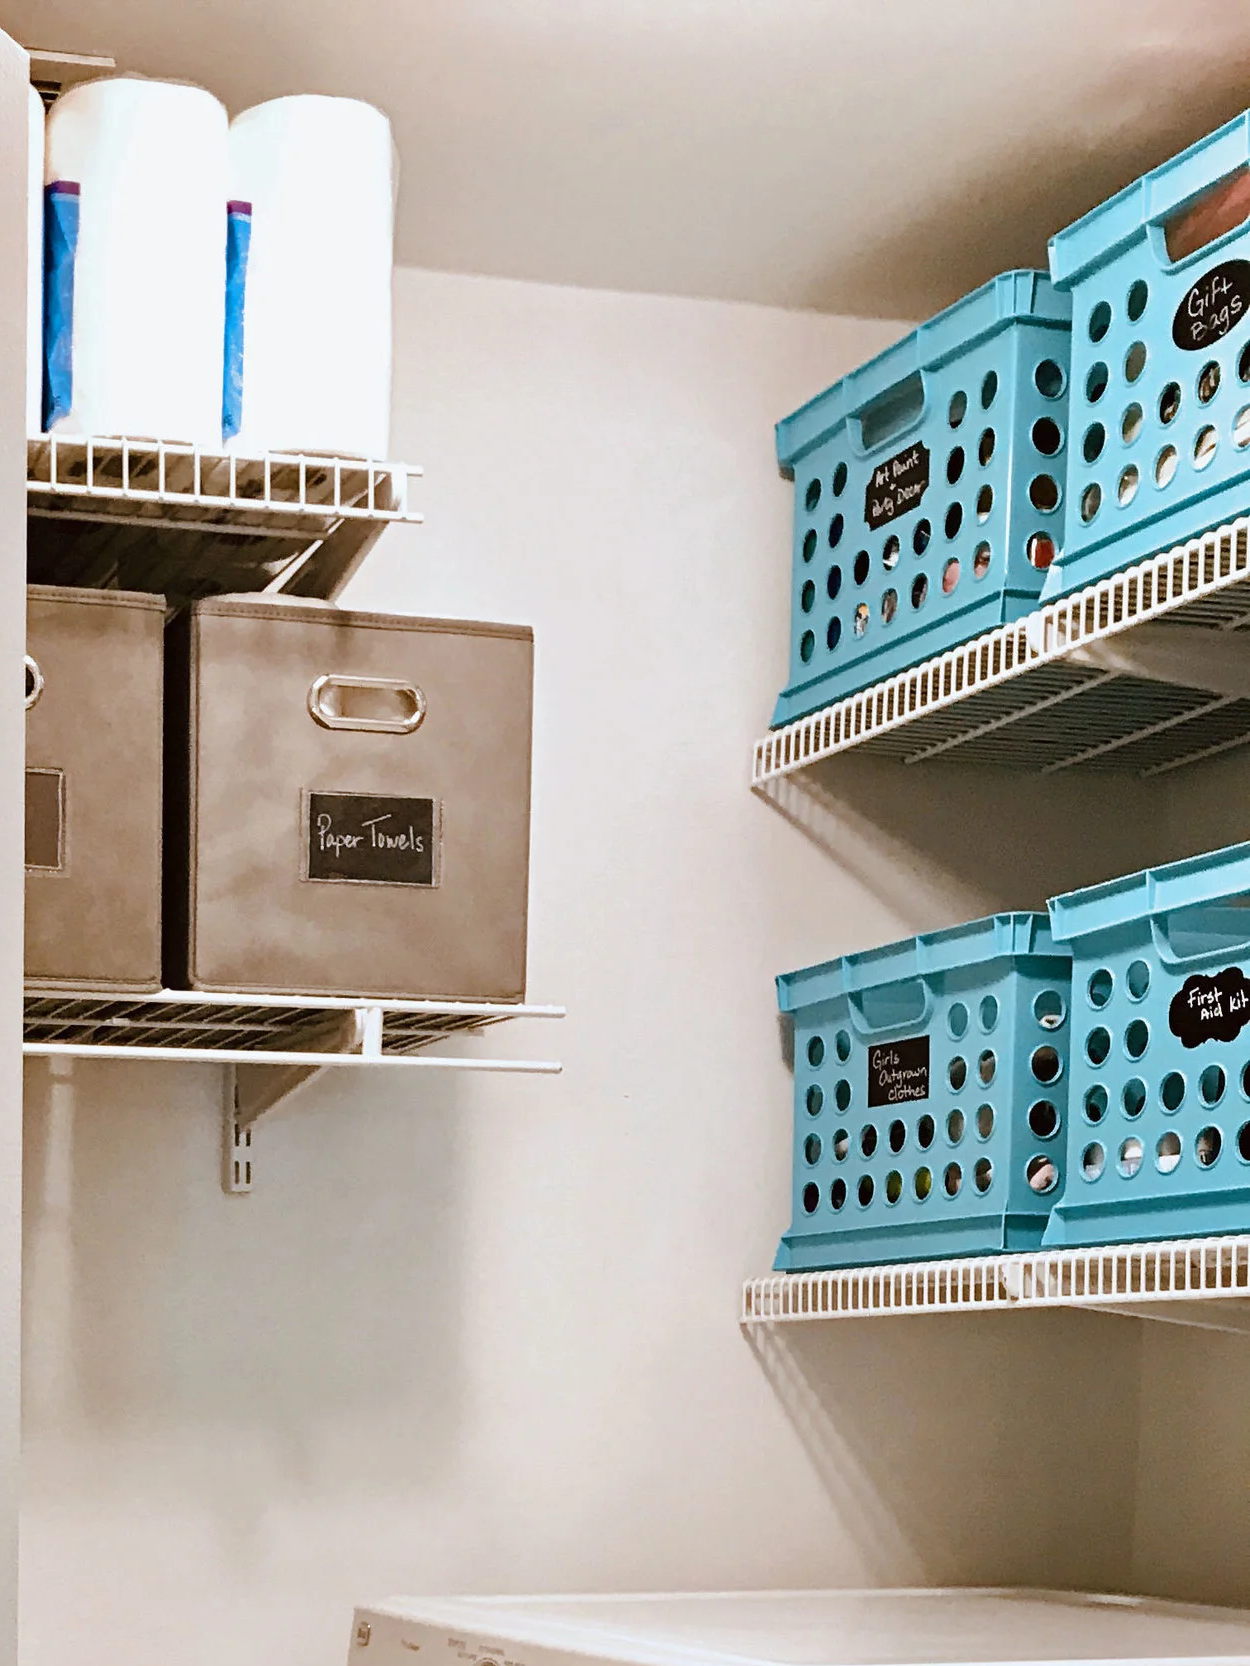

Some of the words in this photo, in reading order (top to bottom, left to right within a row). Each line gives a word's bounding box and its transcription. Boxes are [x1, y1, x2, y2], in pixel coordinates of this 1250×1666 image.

[1188, 276, 1233, 317] Gift
[1191, 295, 1242, 341] Bags
[317, 813, 364, 858] Paper
[361, 813, 424, 853] Towels
[1187, 986, 1223, 1008] First
[1200, 1002, 1223, 1020] Aid
[872, 1049, 900, 1071] Girls
[878, 1067, 927, 1089] Outgrown
